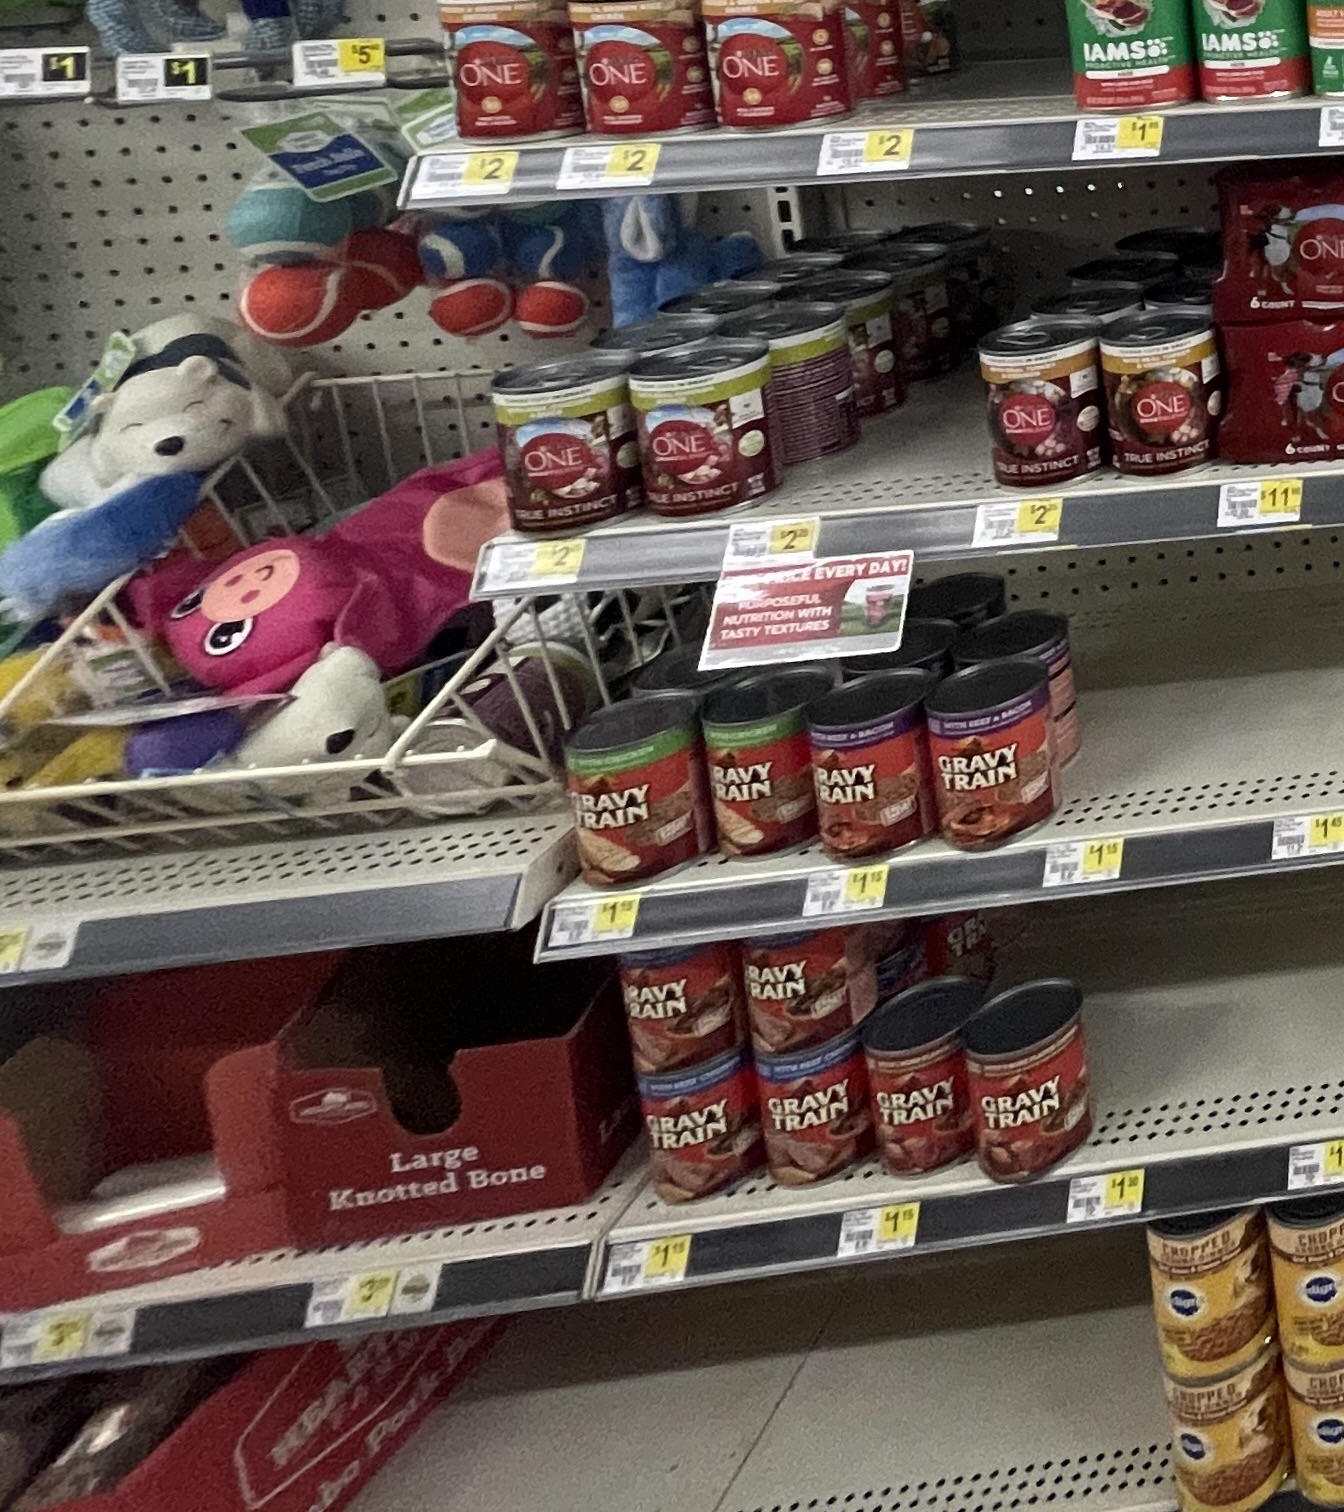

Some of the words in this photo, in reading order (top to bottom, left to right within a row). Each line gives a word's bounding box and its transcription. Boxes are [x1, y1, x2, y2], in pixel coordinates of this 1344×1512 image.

[1083, 41, 1146, 62] IAMS
[1202, 33, 1257, 53] IAMS
[460, 62, 522, 86] ONE
[590, 62, 647, 86] ONE
[723, 56, 780, 80] ONE
[1250, 297, 1260, 309] 6
[1003, 407, 1052, 428] ONE
[1137, 395, 1187, 418] ONE
[525, 447, 582, 469] ONE
[652, 436, 705, 459] ONE
[1124, 451, 1153, 463] TRUE
[1156, 442, 1209, 460] INSTINCT
[1022, 456, 1079, 472] INSTINCT
[677, 484, 736, 500] INSTINCT
[548, 496, 617, 518] INSTINCT
[815, 564, 862, 581] EVERY
[867, 558, 907, 576] DAY!
[739, 595, 820, 609] PURPOSEFUL
[724, 609, 792, 625] NUTRITION
[797, 605, 832, 618] WITH
[721, 626, 760, 639] TASTY
[765, 620, 830, 635] TEXTURES
[940, 745, 1018, 775] GRAVY
[945, 763, 1018, 790] TRAIN
[768, 1081, 848, 1112] GRAVY
[877, 1077, 954, 1110] GRAVY
[982, 1078, 1060, 1112] GRAVY
[772, 1099, 848, 1131] TRAIN
[881, 1096, 954, 1124] TRAIN
[985, 1096, 1060, 1128] TRAIN
[390, 1144, 479, 1173] Large
[330, 1174, 458, 1211] Knotted
[467, 1160, 546, 1189] Bone
